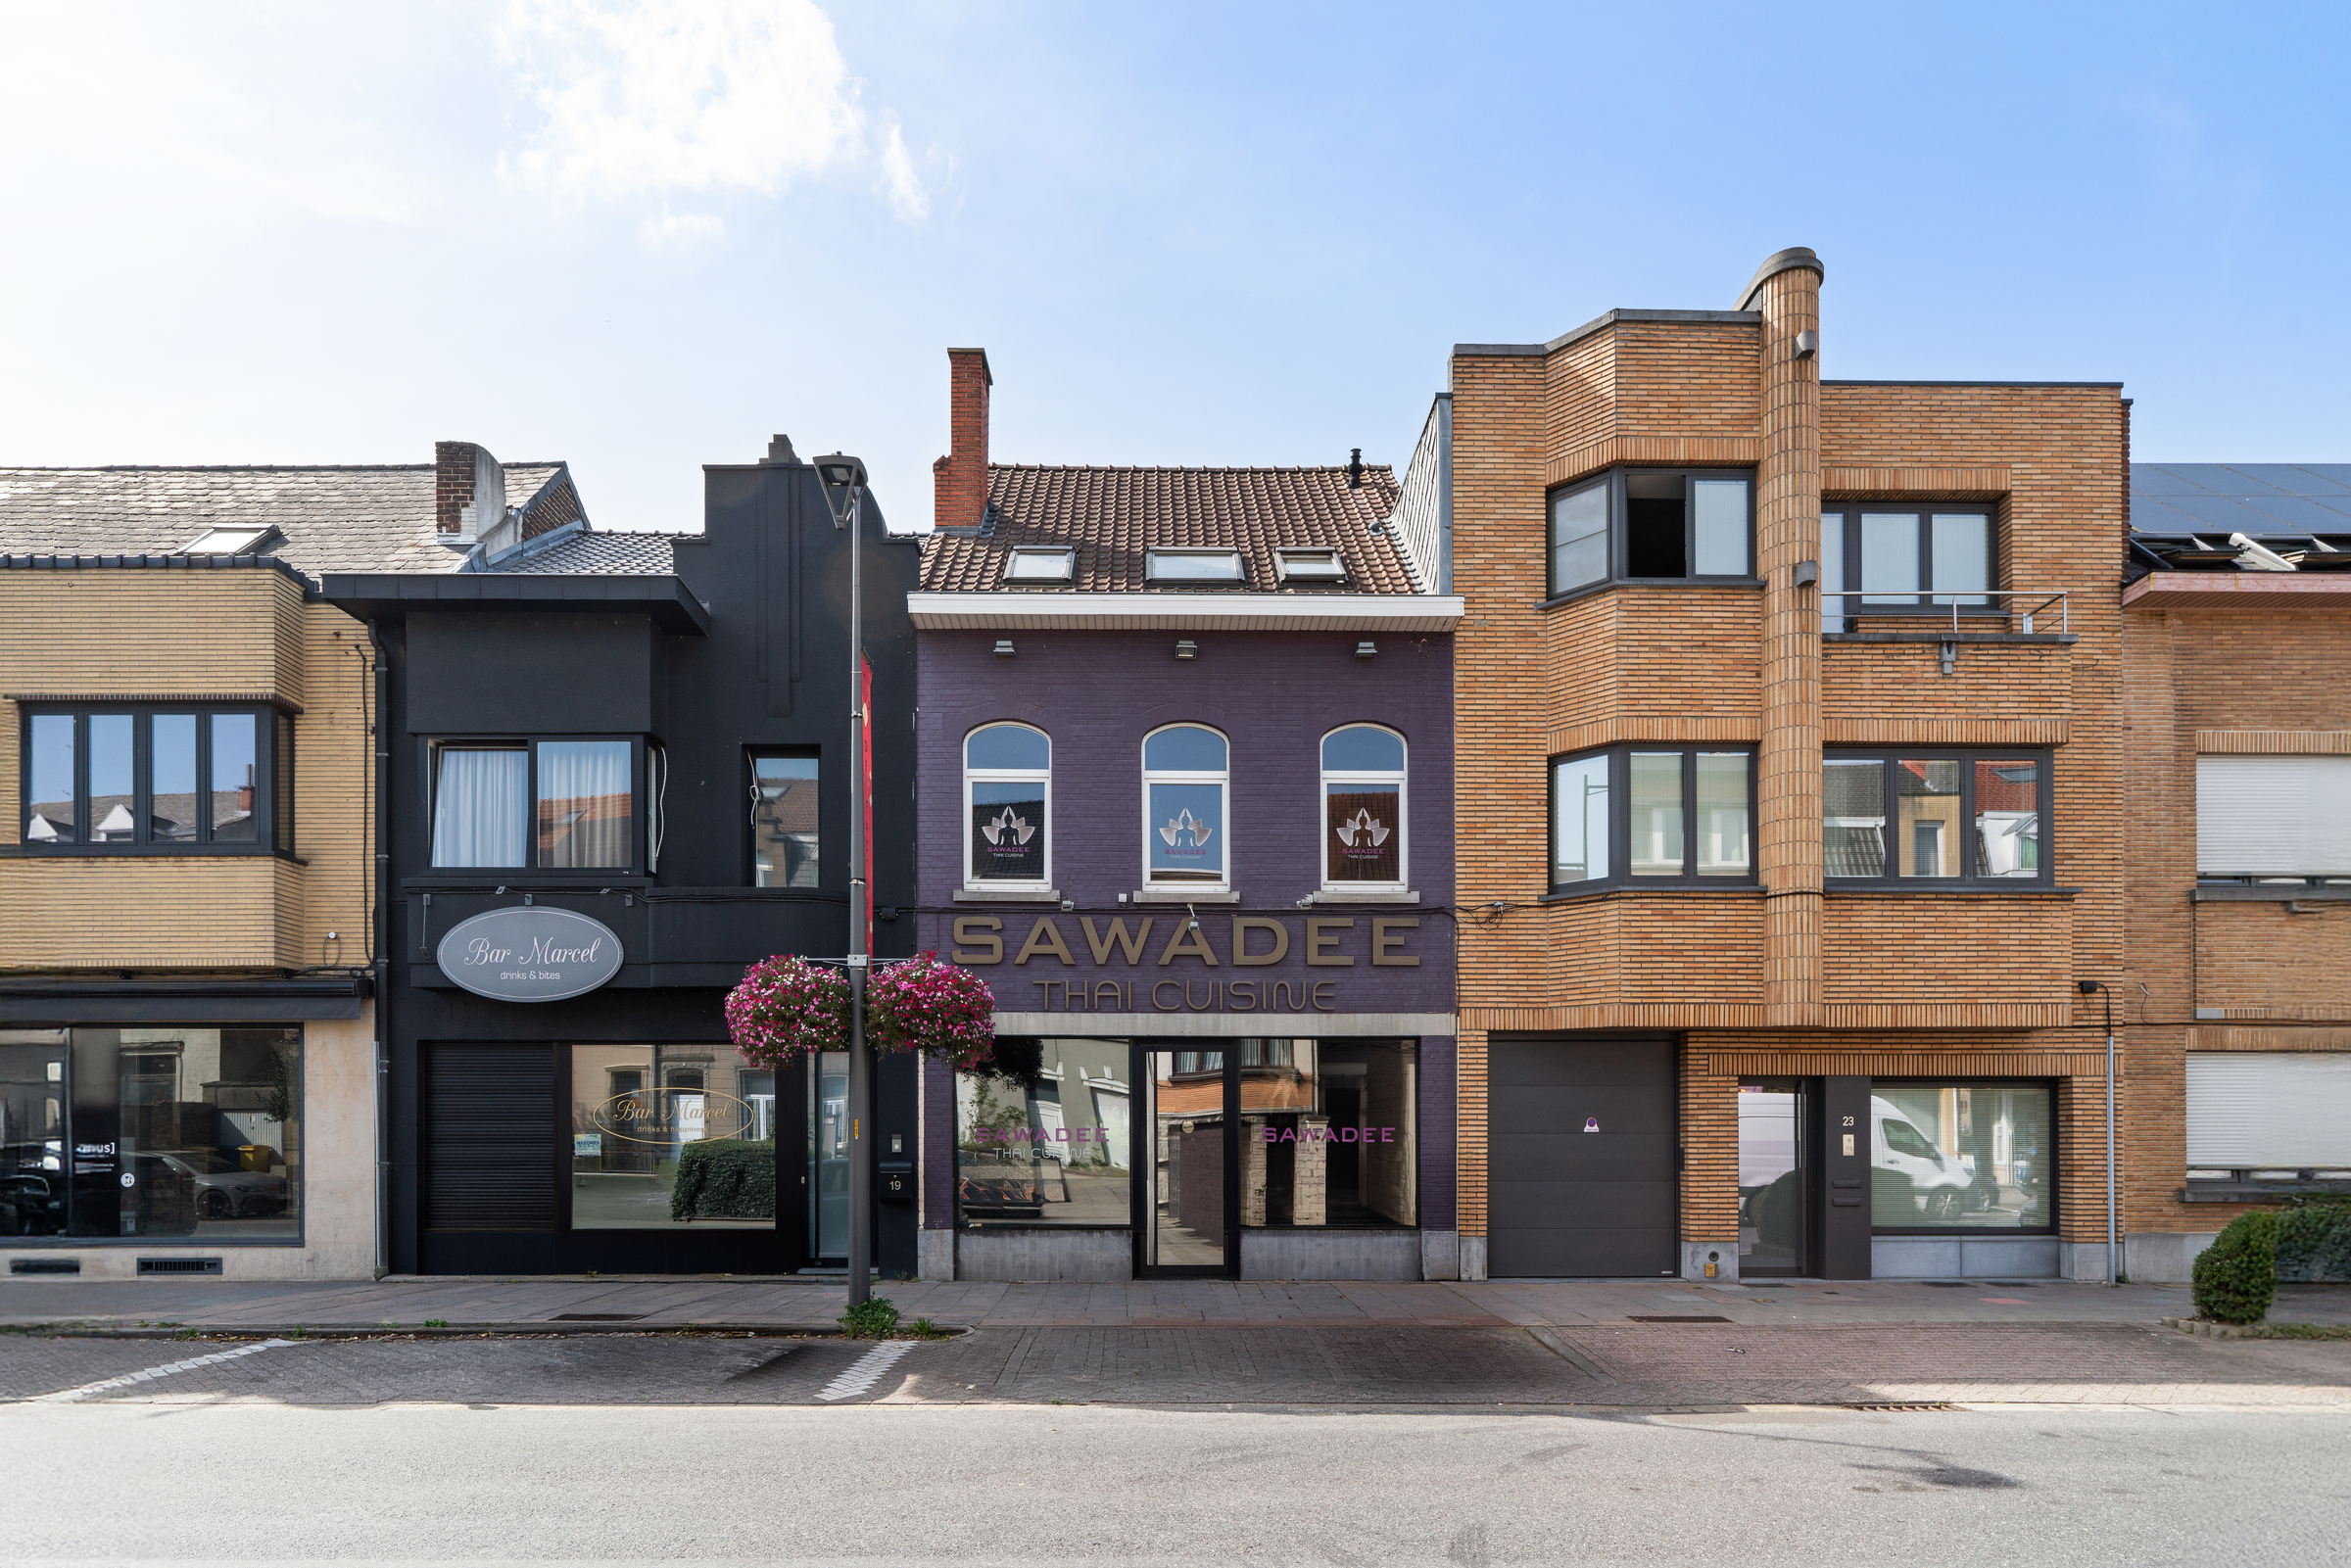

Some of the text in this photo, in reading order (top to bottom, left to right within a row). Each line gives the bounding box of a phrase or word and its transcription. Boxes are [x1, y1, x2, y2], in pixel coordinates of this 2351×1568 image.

[951, 917, 1420, 967] SAWADEE
[463, 936, 601, 966] Bar Marcel
[500, 970, 560, 980] drinks & bites
[1032, 980, 1335, 1011] THAI CUISINE
[613, 1099, 733, 1121] Bar Marcel
[1843, 1116, 1854, 1126] 23
[975, 1127, 1110, 1143] SAWADEE
[1262, 1127, 1396, 1143] SAWADEE
[992, 1148, 1026, 1160] THAI
[889, 1180, 901, 1191] 19
